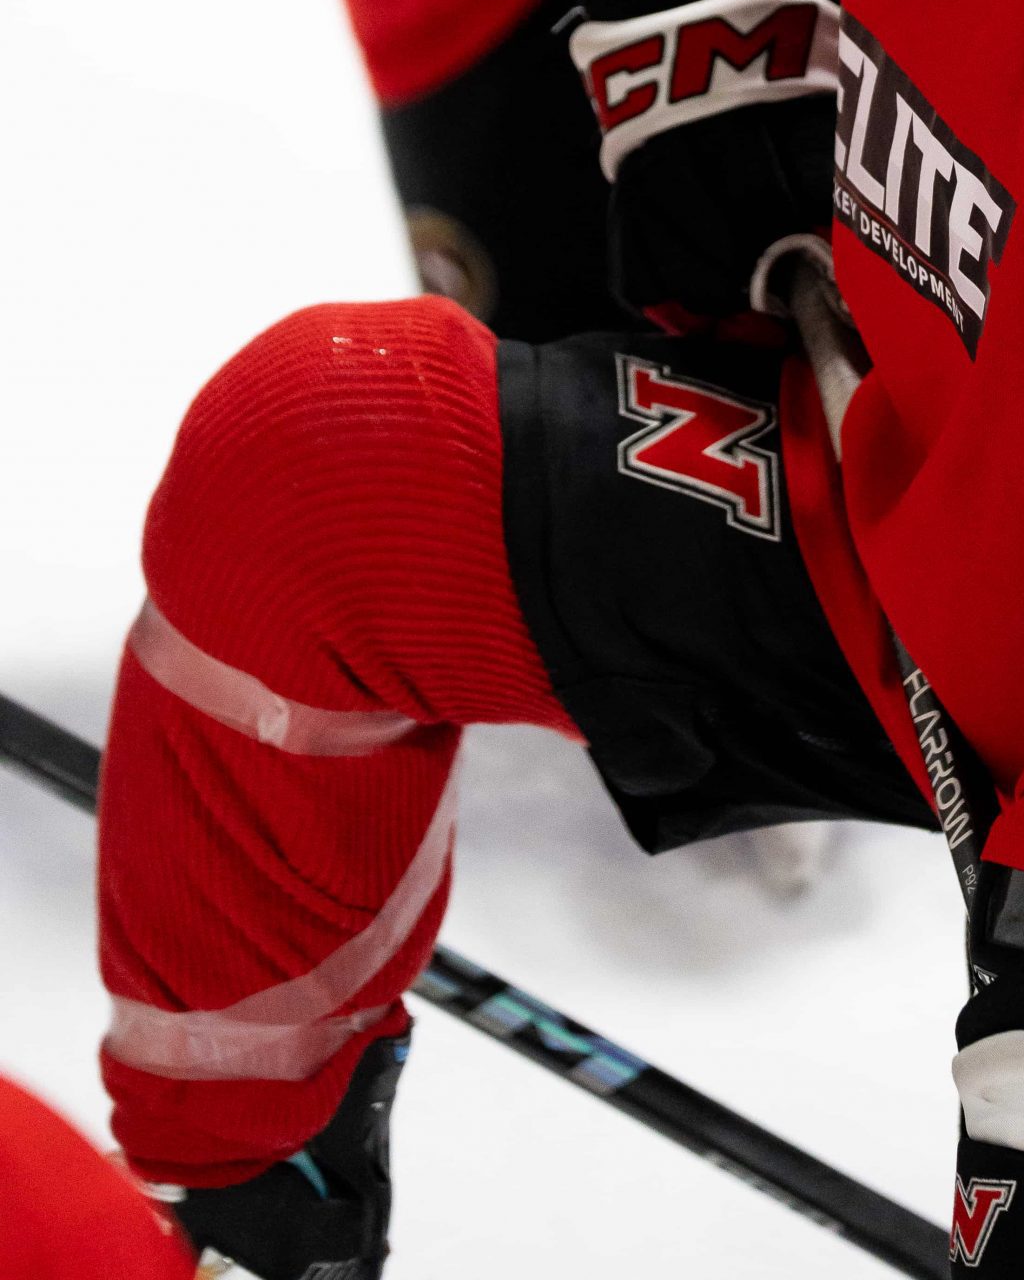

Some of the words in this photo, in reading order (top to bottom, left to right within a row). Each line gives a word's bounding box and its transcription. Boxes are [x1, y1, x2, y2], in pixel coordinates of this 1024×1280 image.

[583, 2, 818, 133] CM
[860, 211, 964, 333] DEVELOPMENT
[615, 352, 781, 542] N
